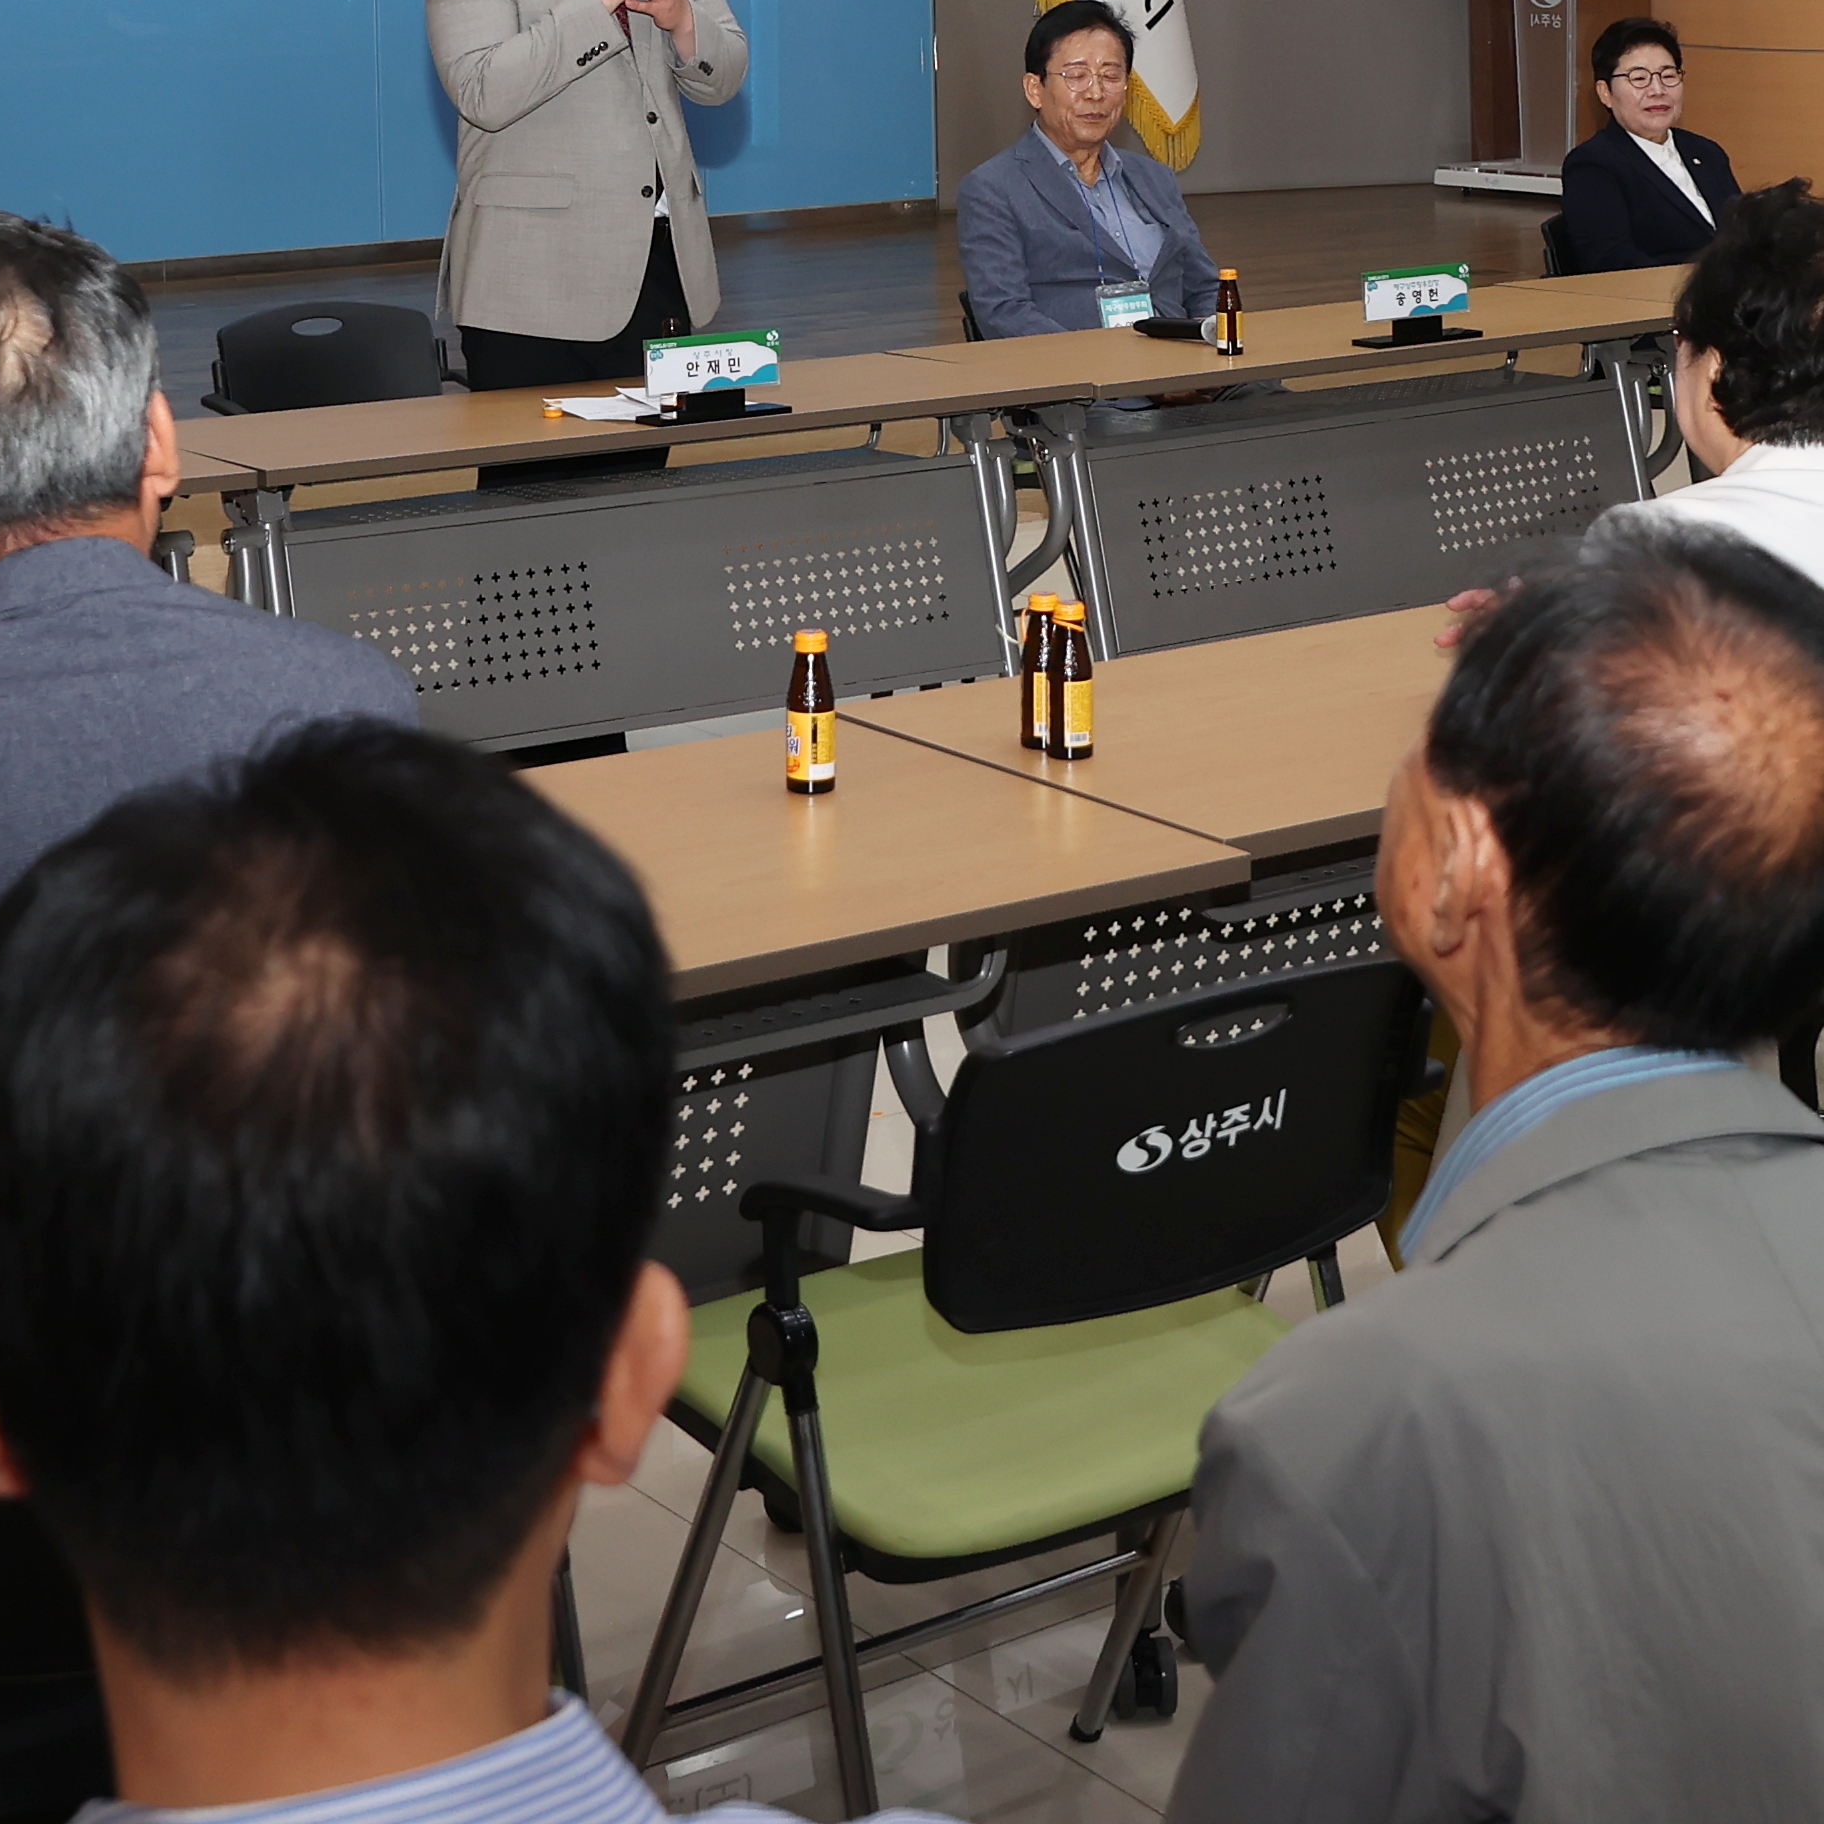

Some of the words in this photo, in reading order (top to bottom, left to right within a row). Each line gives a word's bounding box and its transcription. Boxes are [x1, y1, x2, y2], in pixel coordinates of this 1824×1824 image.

[1395, 288, 1439, 306] 송영헌
[686, 357, 741, 378] 안재민
[1178, 1088, 1288, 1160] 상주시
